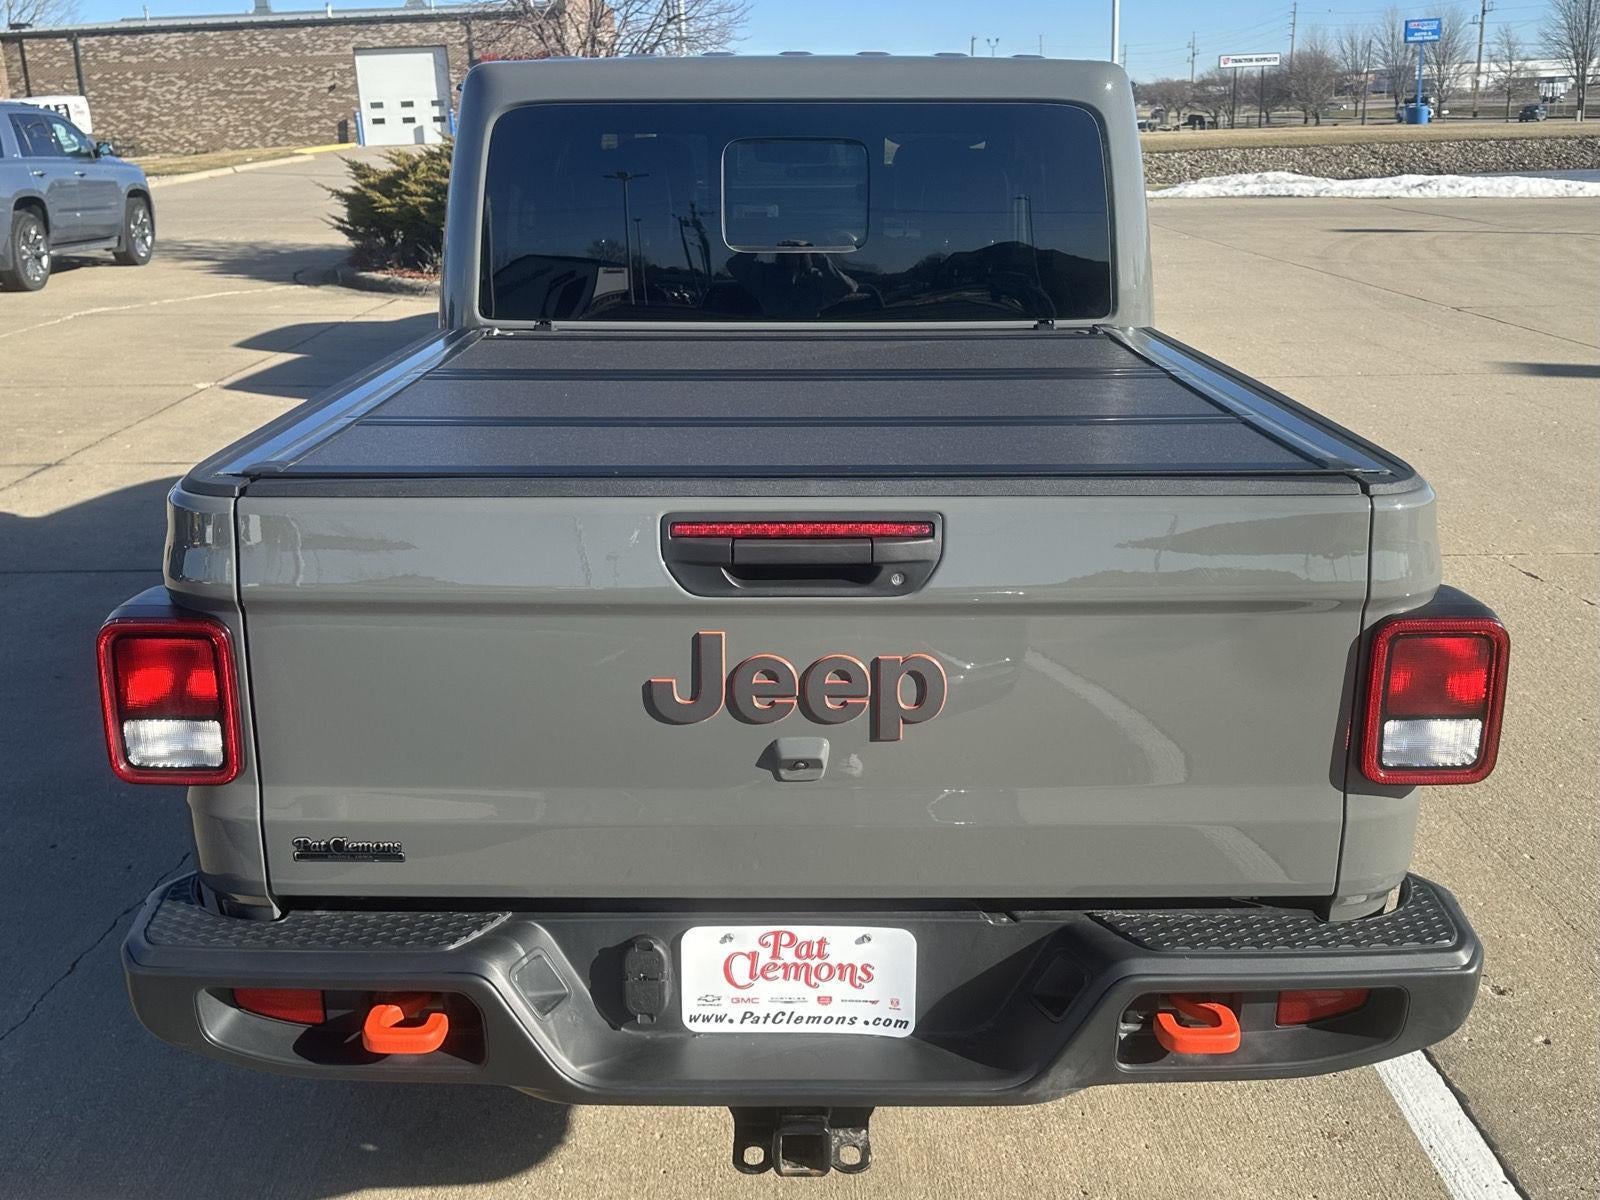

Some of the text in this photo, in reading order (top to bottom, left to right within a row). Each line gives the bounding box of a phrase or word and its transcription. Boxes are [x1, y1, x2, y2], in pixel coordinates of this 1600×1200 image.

[642, 631, 948, 742] Jeep
[292, 836, 402, 854] Pat Clemons
[758, 930, 830, 960] Pat
[723, 950, 875, 990] Clemons
[730, 996, 760, 1005] GMC
